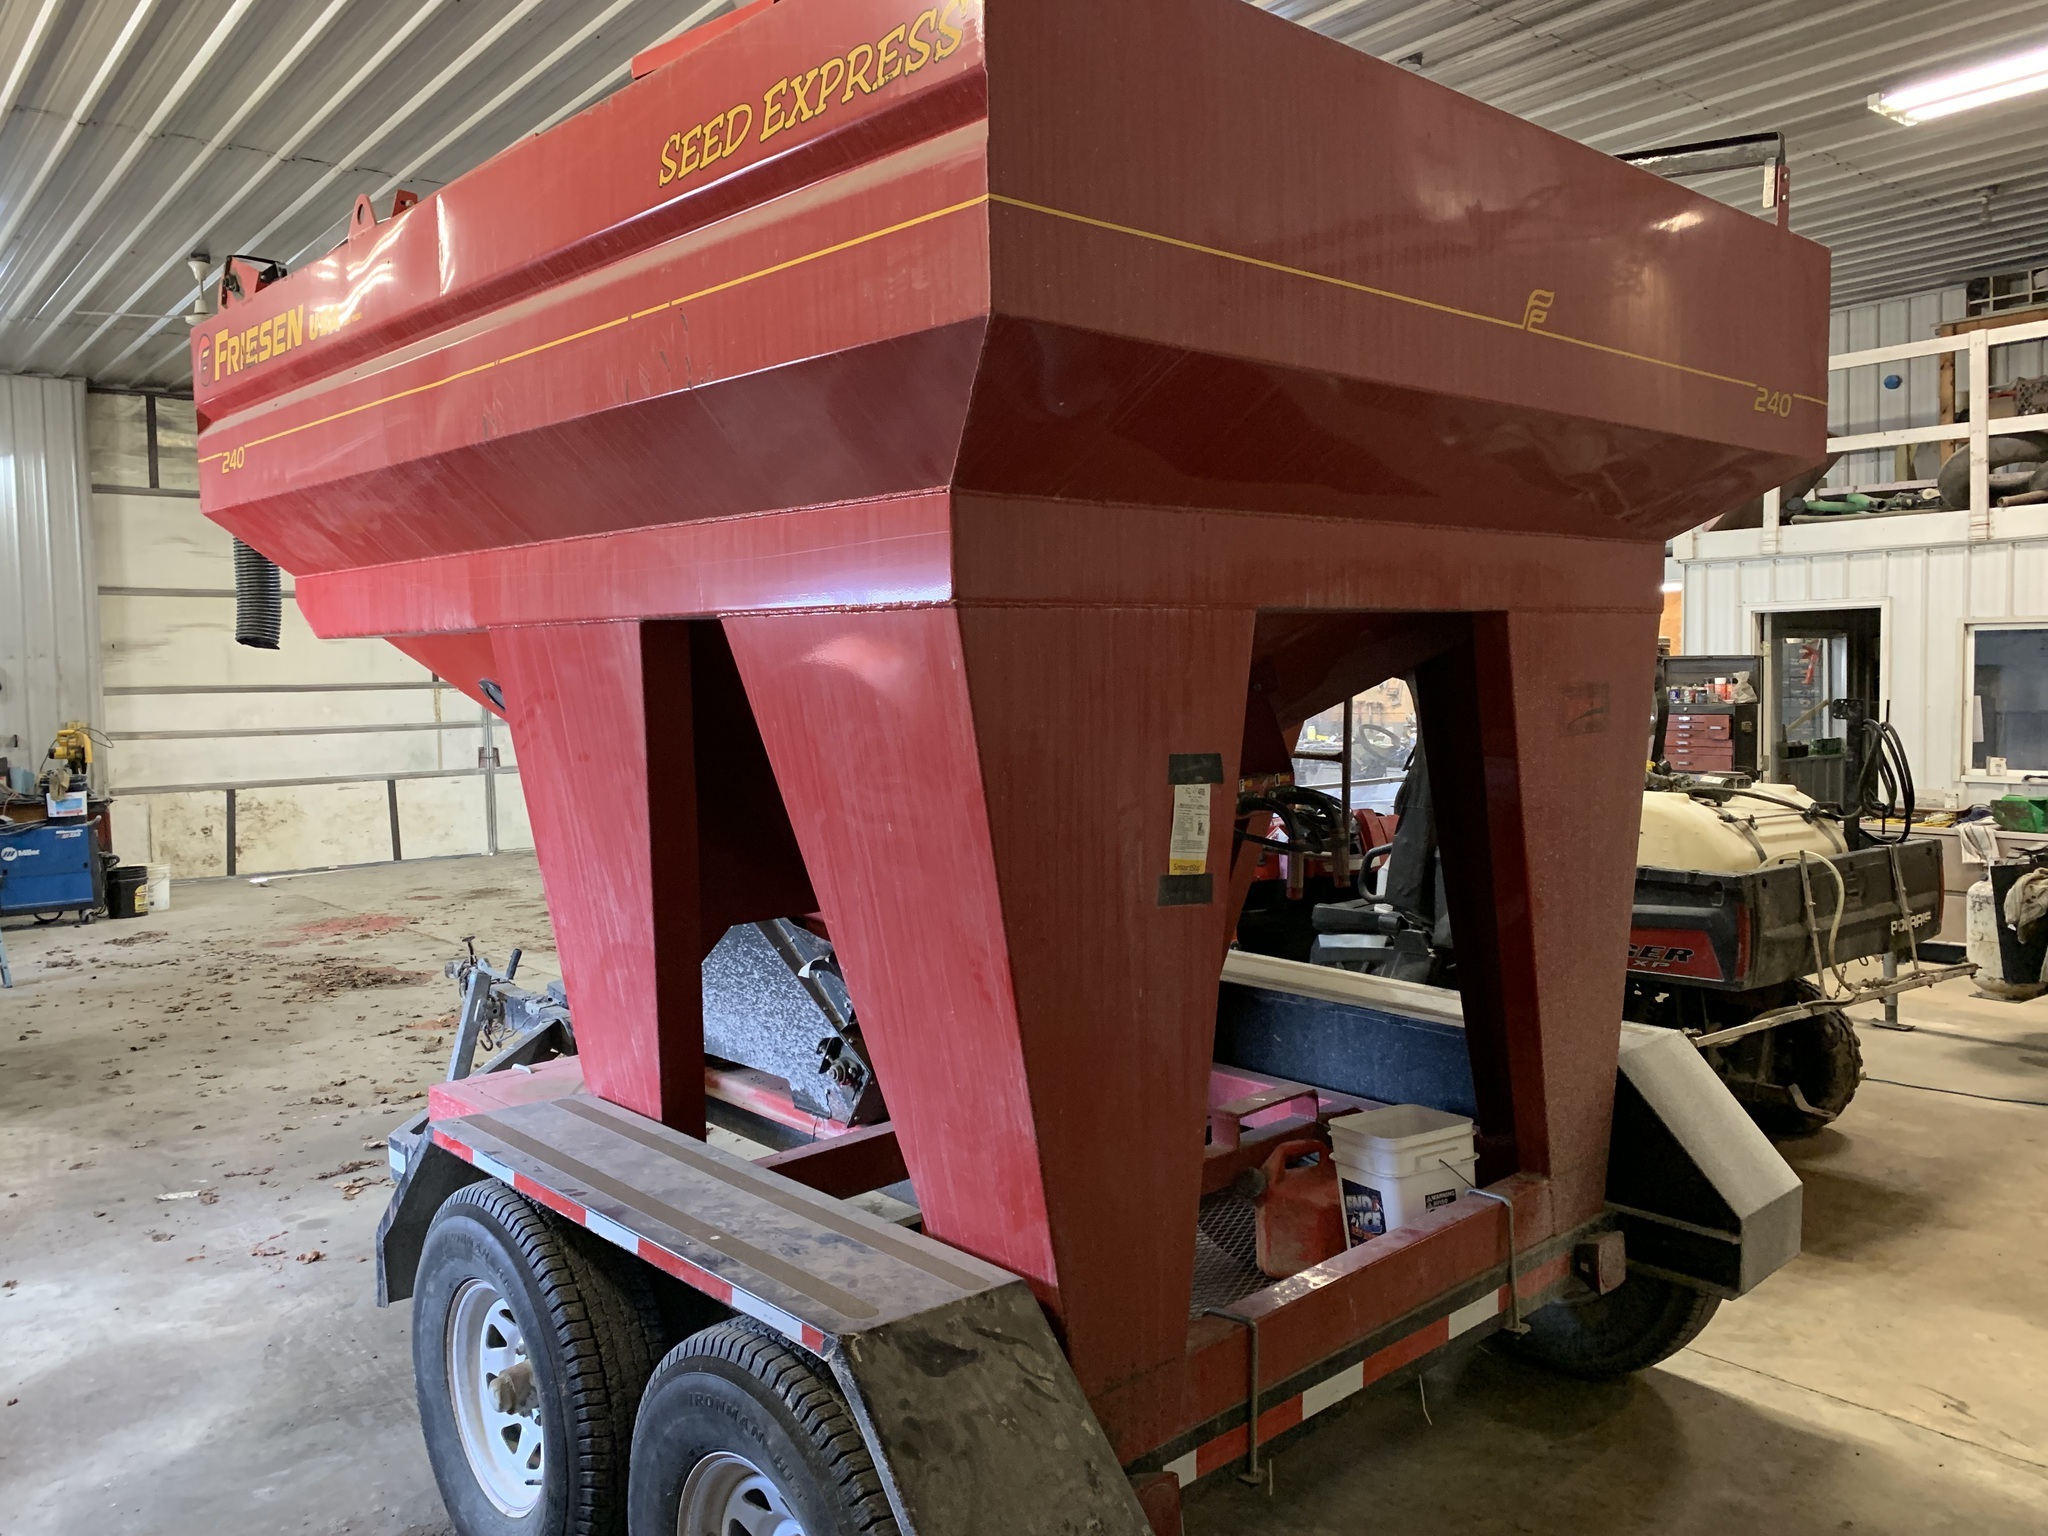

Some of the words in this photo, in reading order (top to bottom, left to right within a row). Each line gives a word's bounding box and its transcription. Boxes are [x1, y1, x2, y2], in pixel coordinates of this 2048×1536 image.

[658, 103, 753, 187] SEED
[759, 0, 968, 143] EXPRESS
[214, 304, 304, 382] FRIESEN
[1754, 386, 1792, 417] 240
[221, 446, 245, 474] 240
[1632, 960, 1671, 968] XP
[688, 1391, 765, 1443] IRONMAN
